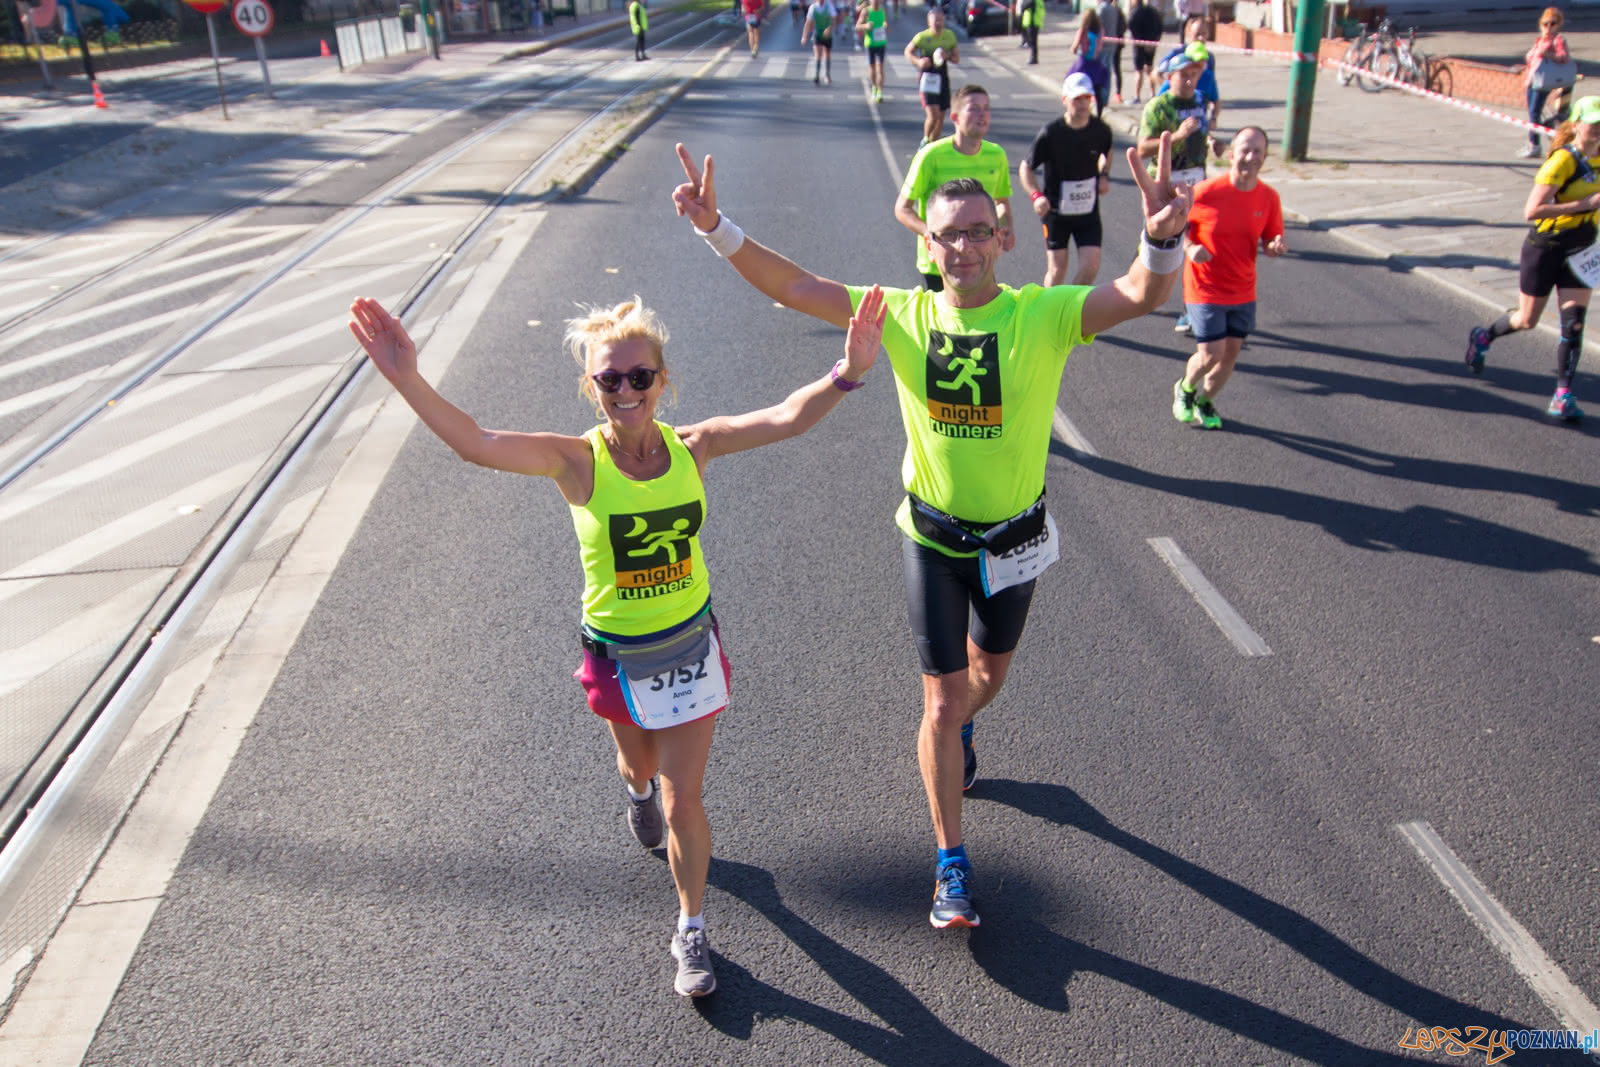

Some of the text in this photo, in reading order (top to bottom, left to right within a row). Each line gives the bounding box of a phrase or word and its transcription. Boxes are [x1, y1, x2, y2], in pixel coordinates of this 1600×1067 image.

[239, 5, 267, 25] 40
[941, 404, 988, 424] night
[929, 416, 1002, 438] runners
[633, 563, 684, 584] night
[617, 574, 693, 600] runners
[650, 659, 708, 692] 3752
[673, 689, 693, 699] Anna
